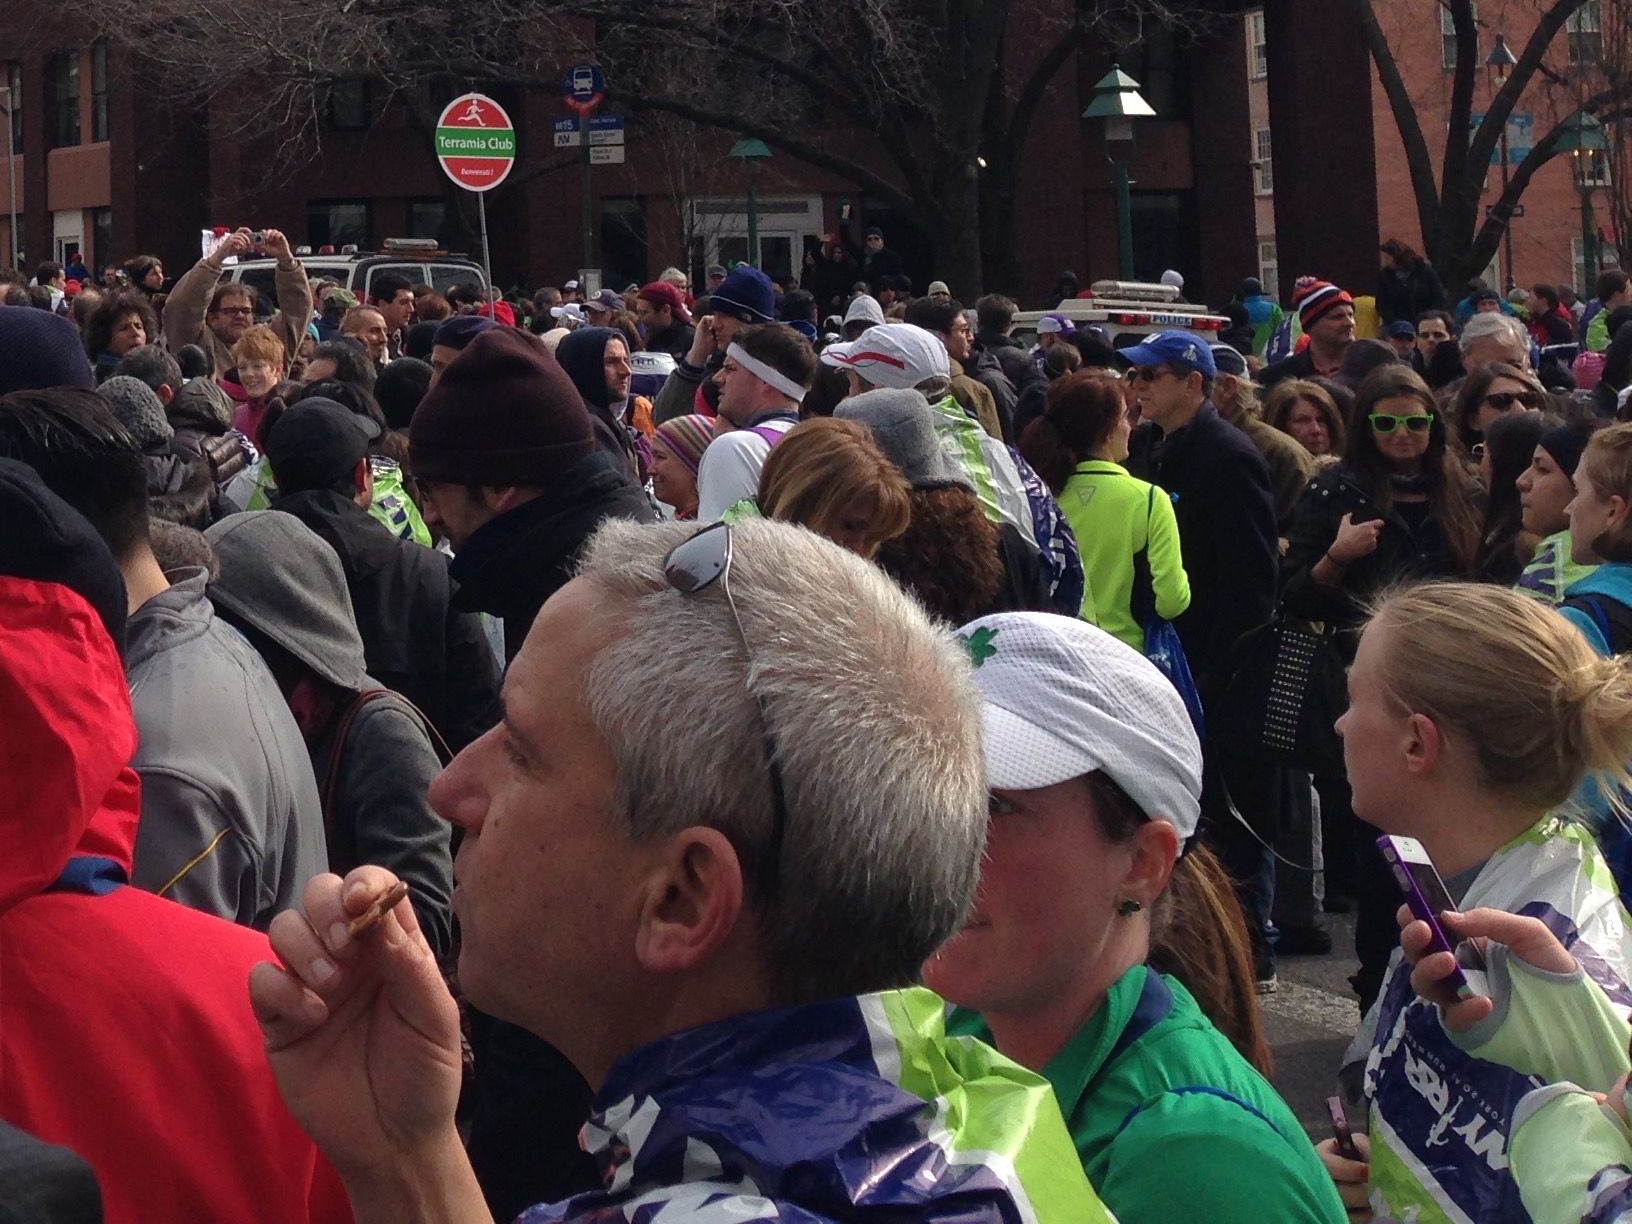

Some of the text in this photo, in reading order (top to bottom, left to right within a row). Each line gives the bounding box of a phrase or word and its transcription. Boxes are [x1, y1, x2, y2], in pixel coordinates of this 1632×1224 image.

[439, 136, 513, 149] Terramia Club
[1152, 315, 1191, 325] POLICE
